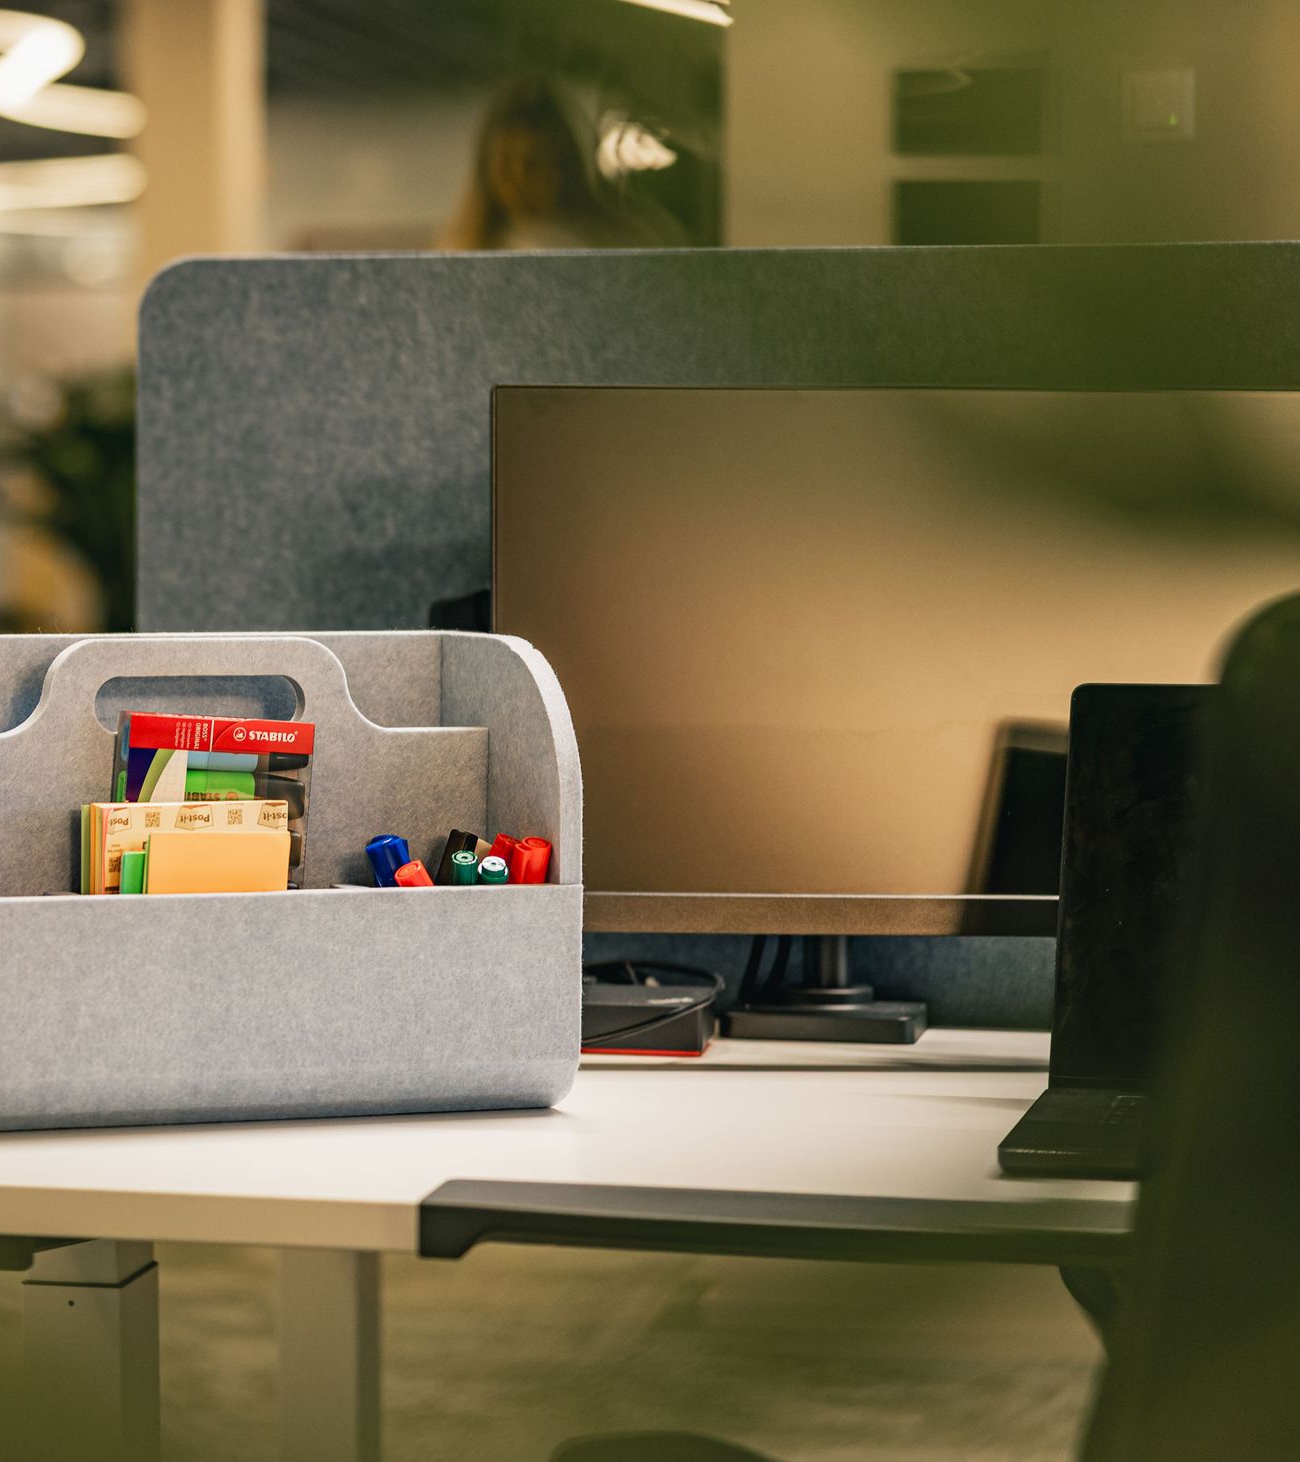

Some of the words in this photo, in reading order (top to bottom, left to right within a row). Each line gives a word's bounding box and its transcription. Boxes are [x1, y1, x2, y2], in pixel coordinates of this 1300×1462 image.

[193, 722, 202, 750] ORIGINAL
[249, 730, 295, 743] STABILO
[179, 814, 210, 824] Post-it
